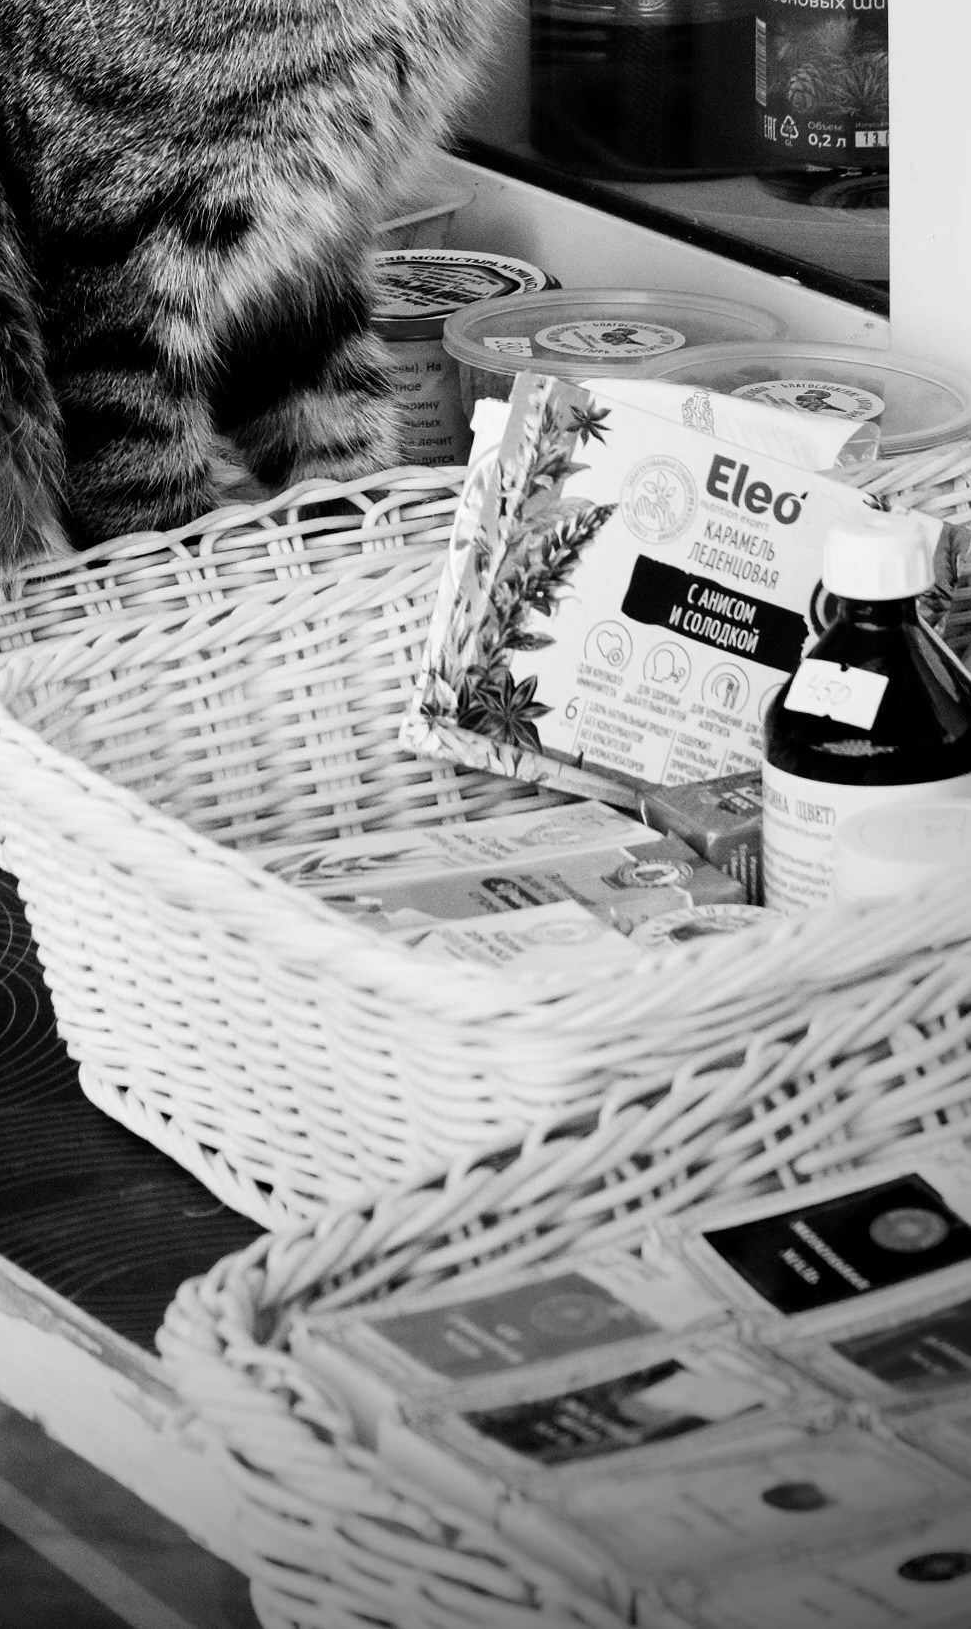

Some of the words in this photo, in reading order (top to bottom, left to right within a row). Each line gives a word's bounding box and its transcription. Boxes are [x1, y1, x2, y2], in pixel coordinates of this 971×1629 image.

[808, 133, 832, 149] 0,2
[835, 137, 847, 148] л
[427, 363, 442, 372] На
[703, 518, 776, 562] КАРАМЕЛЬ
[687, 541, 780, 590] ЛЕДЕНЦОВАЯ
[687, 583, 698, 604] С
[697, 588, 756, 625] АНИСОМ
[669, 604, 683, 626] И
[683, 609, 760, 654] СОЛОДКОЙ
[565, 696, 579, 720] 6
